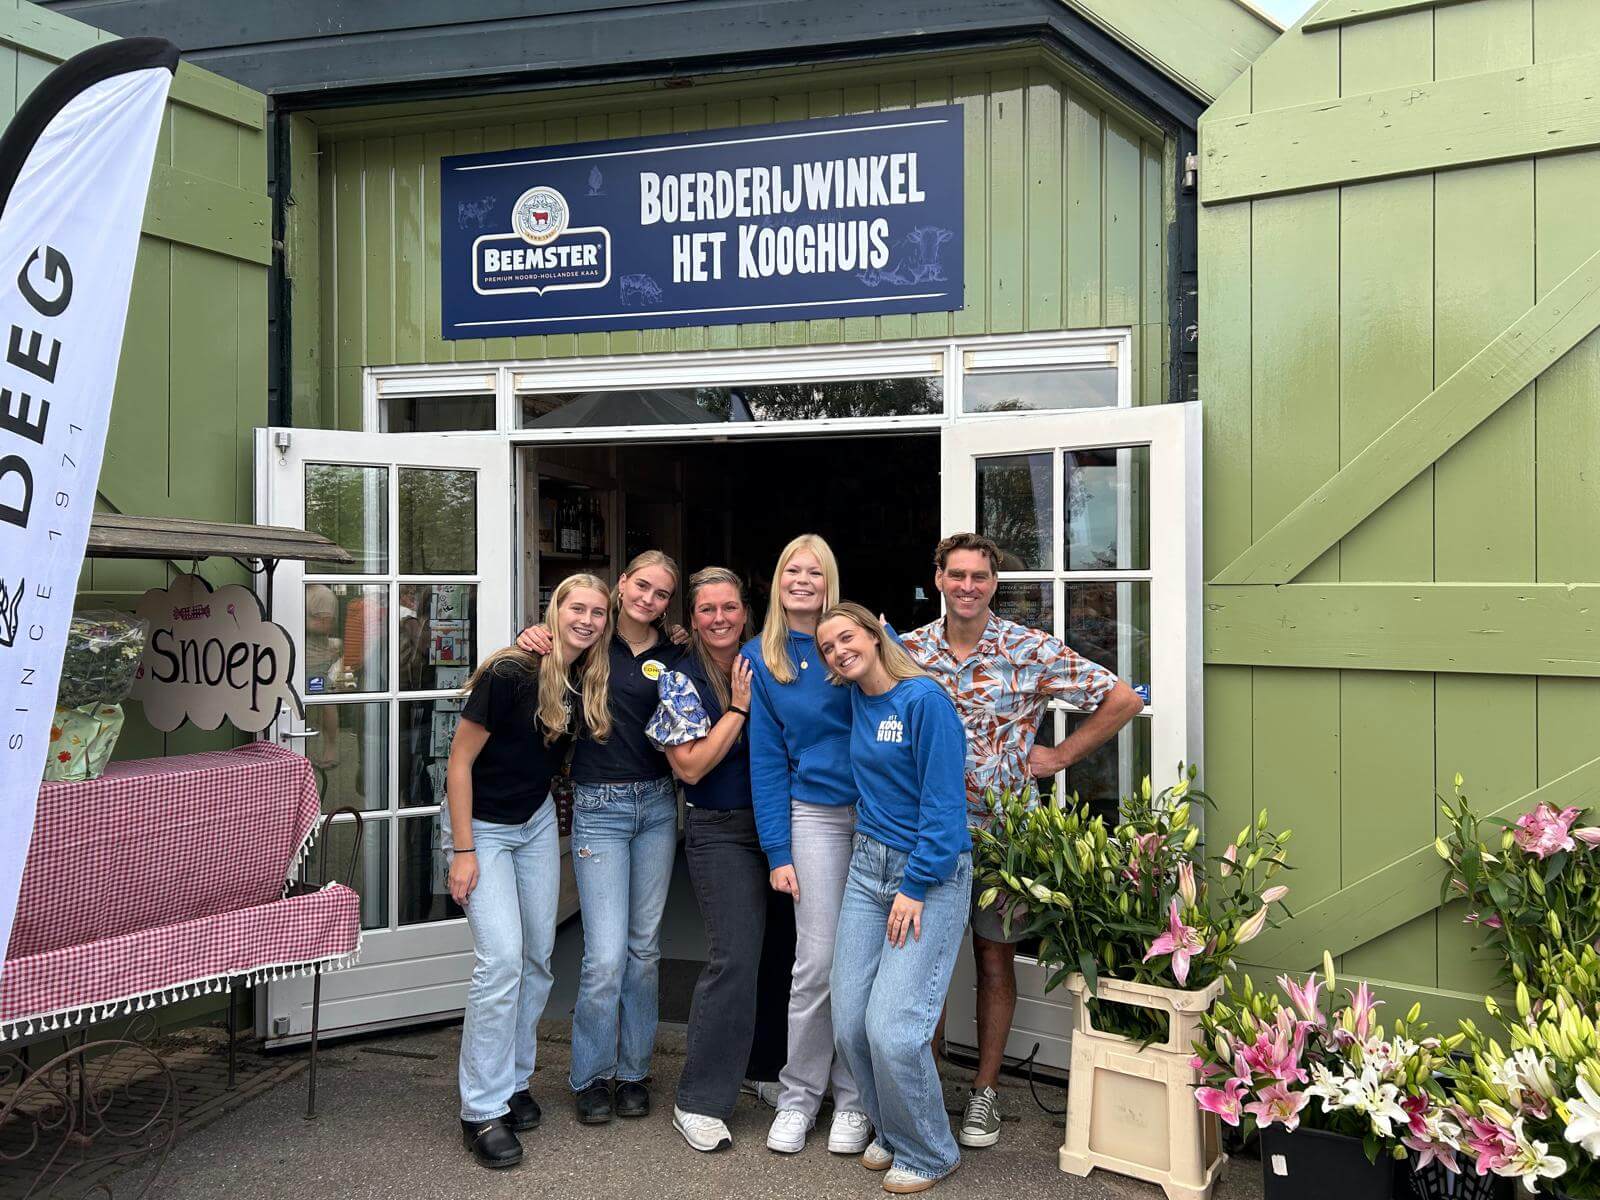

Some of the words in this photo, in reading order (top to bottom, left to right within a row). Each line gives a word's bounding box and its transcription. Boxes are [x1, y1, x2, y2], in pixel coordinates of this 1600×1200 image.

[640, 152, 926, 225] BOERDERIJWINKEL
[515, 271, 579, 280] NOORD-HOLLANDSE
[673, 232, 727, 282] HET
[738, 218, 889, 279] KOOGHUIS
[9, 583, 53, 750] SINCE
[48, 423, 83, 540] 1971
[152, 628, 276, 711] Snoep
[876, 730, 903, 742] HUIS
[879, 720, 903, 730] KOOG
